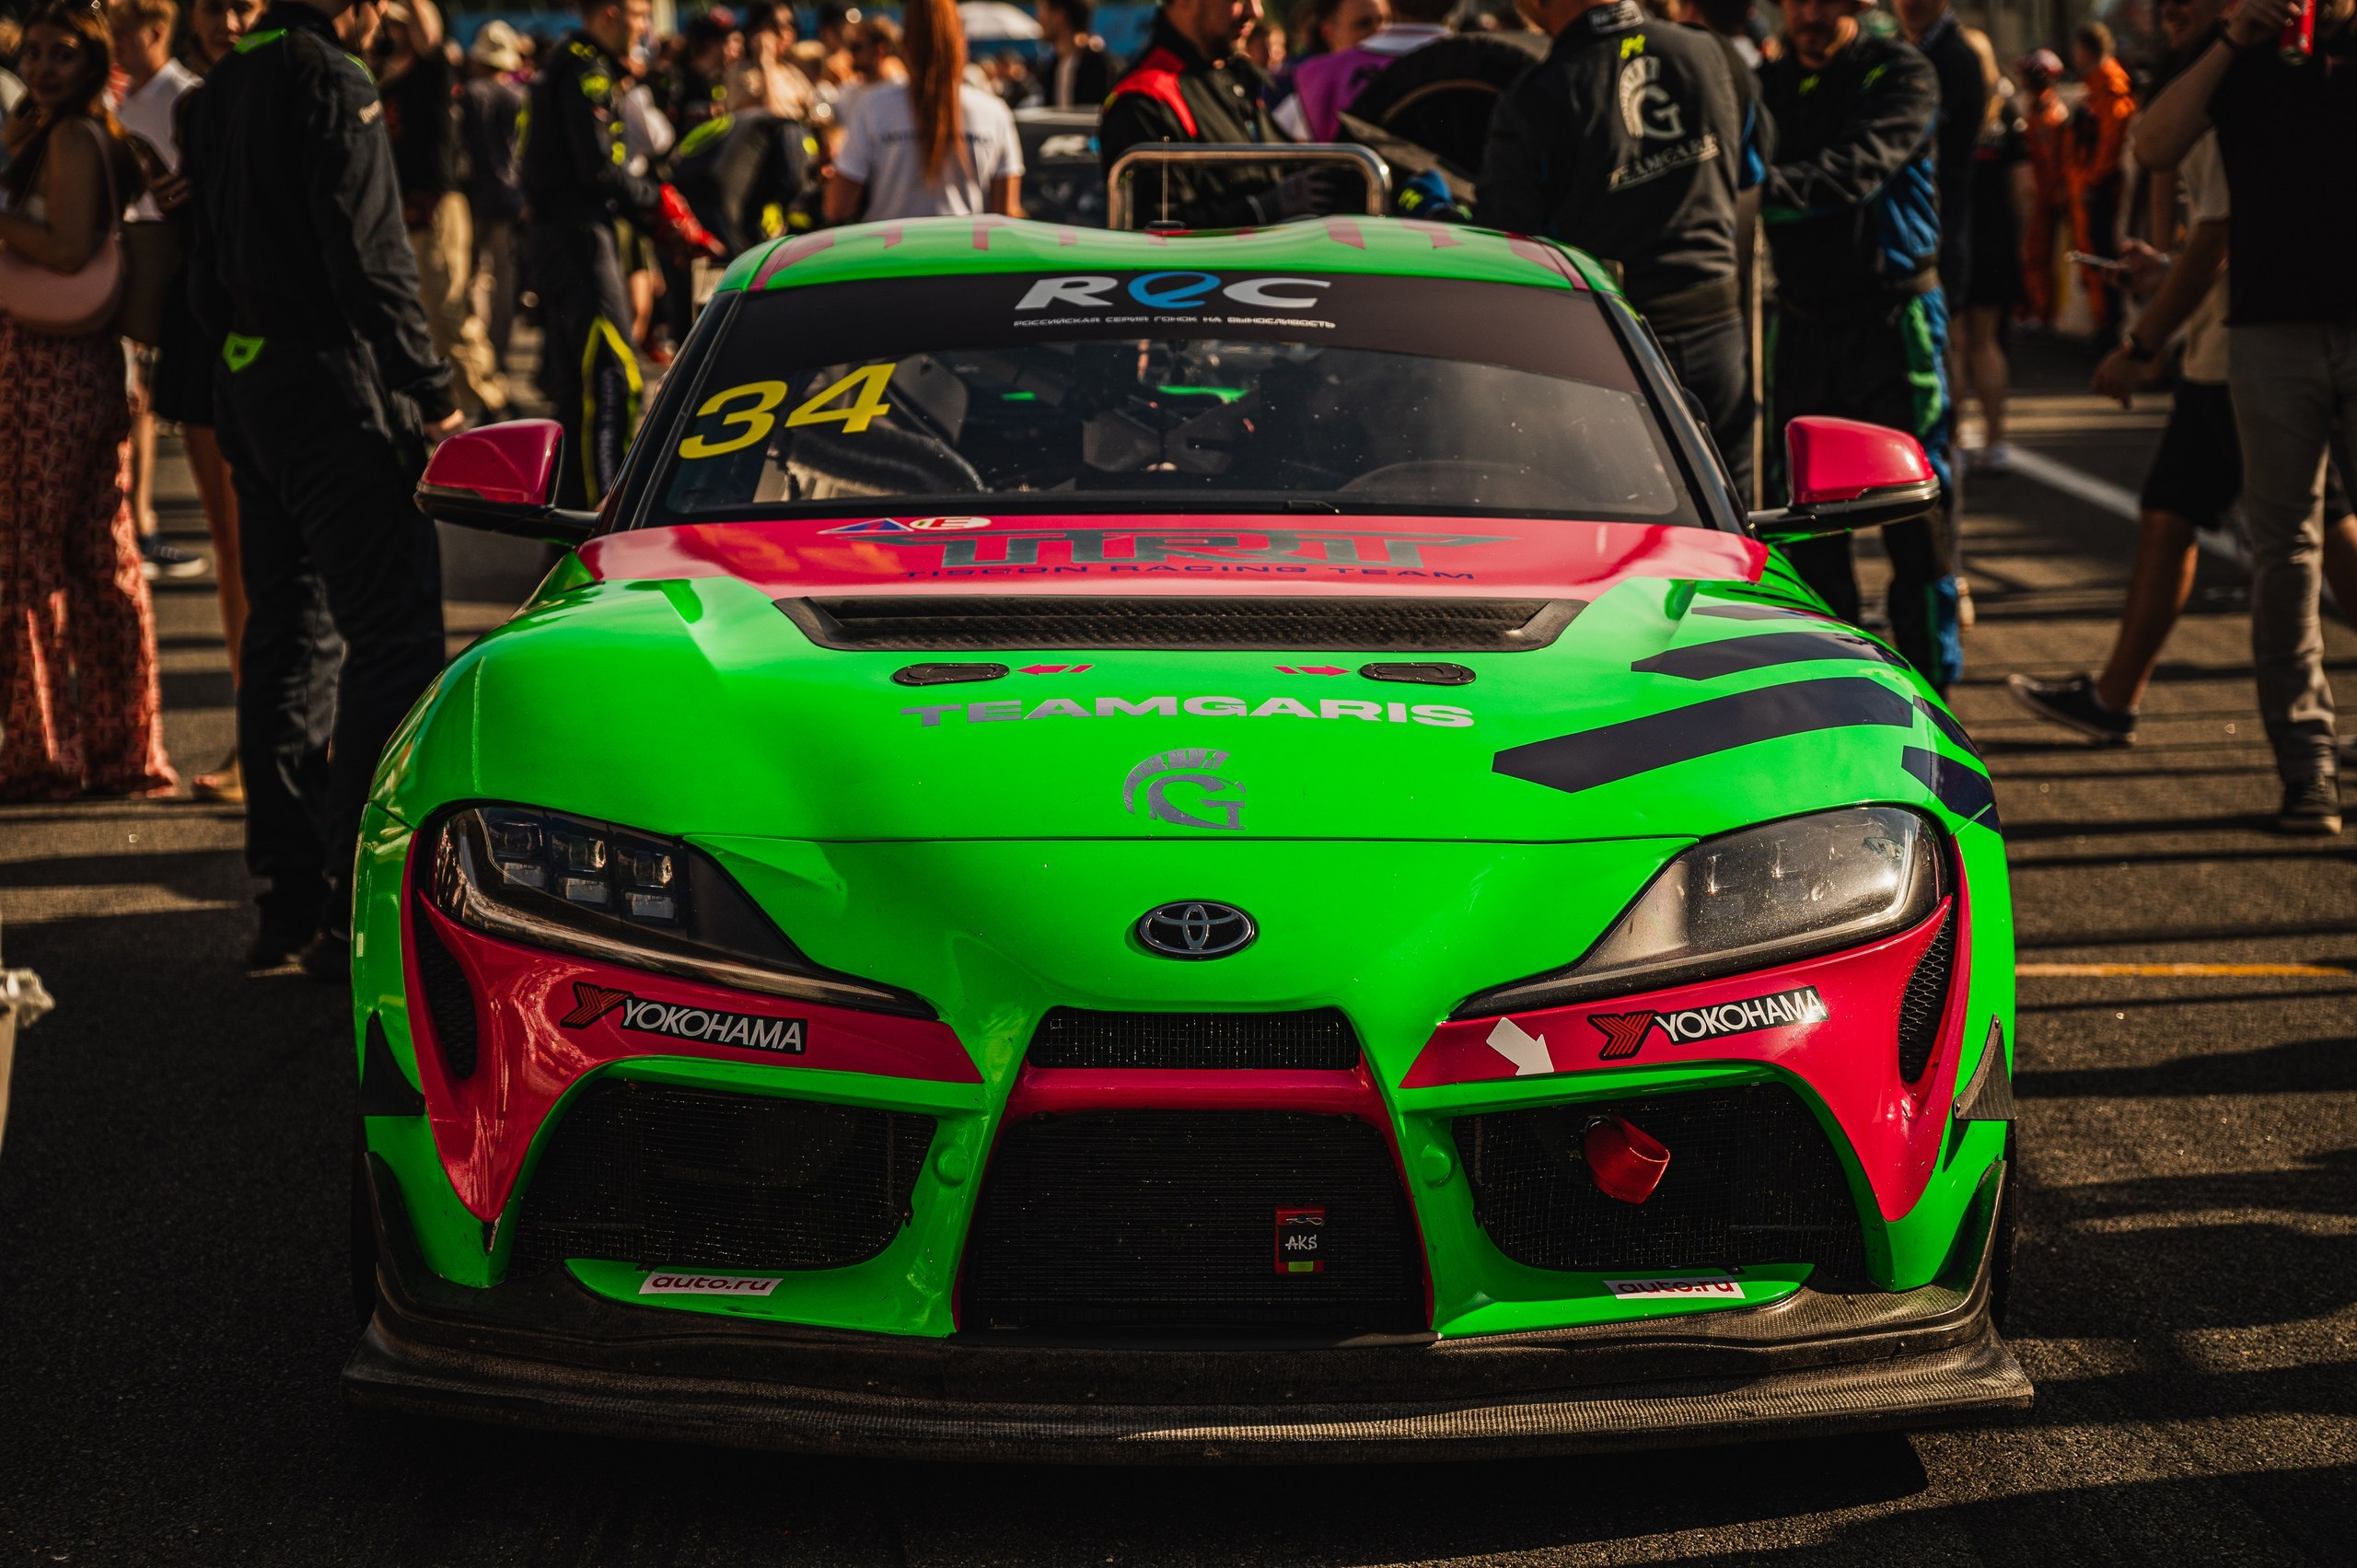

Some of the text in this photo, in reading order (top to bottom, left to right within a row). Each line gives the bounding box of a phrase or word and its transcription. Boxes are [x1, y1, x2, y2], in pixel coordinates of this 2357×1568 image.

[1014, 315, 1336, 330] РОССИЙСКАЯ СЕРИЯ ГОНОК НА ВЫНОСЛИВОСТЬ
[678, 362, 897, 460] 34
[900, 564, 1475, 580] TISCON RACING TEAM
[900, 696, 1475, 728] TEAMGARIS
[1654, 989, 1828, 1042] YOKOHAMA
[622, 999, 804, 1052] YOKOHAMA
[1284, 1234, 1318, 1250] AKS
[652, 1276, 771, 1291] auto.ru
[1618, 1280, 1735, 1294] auto.ru
